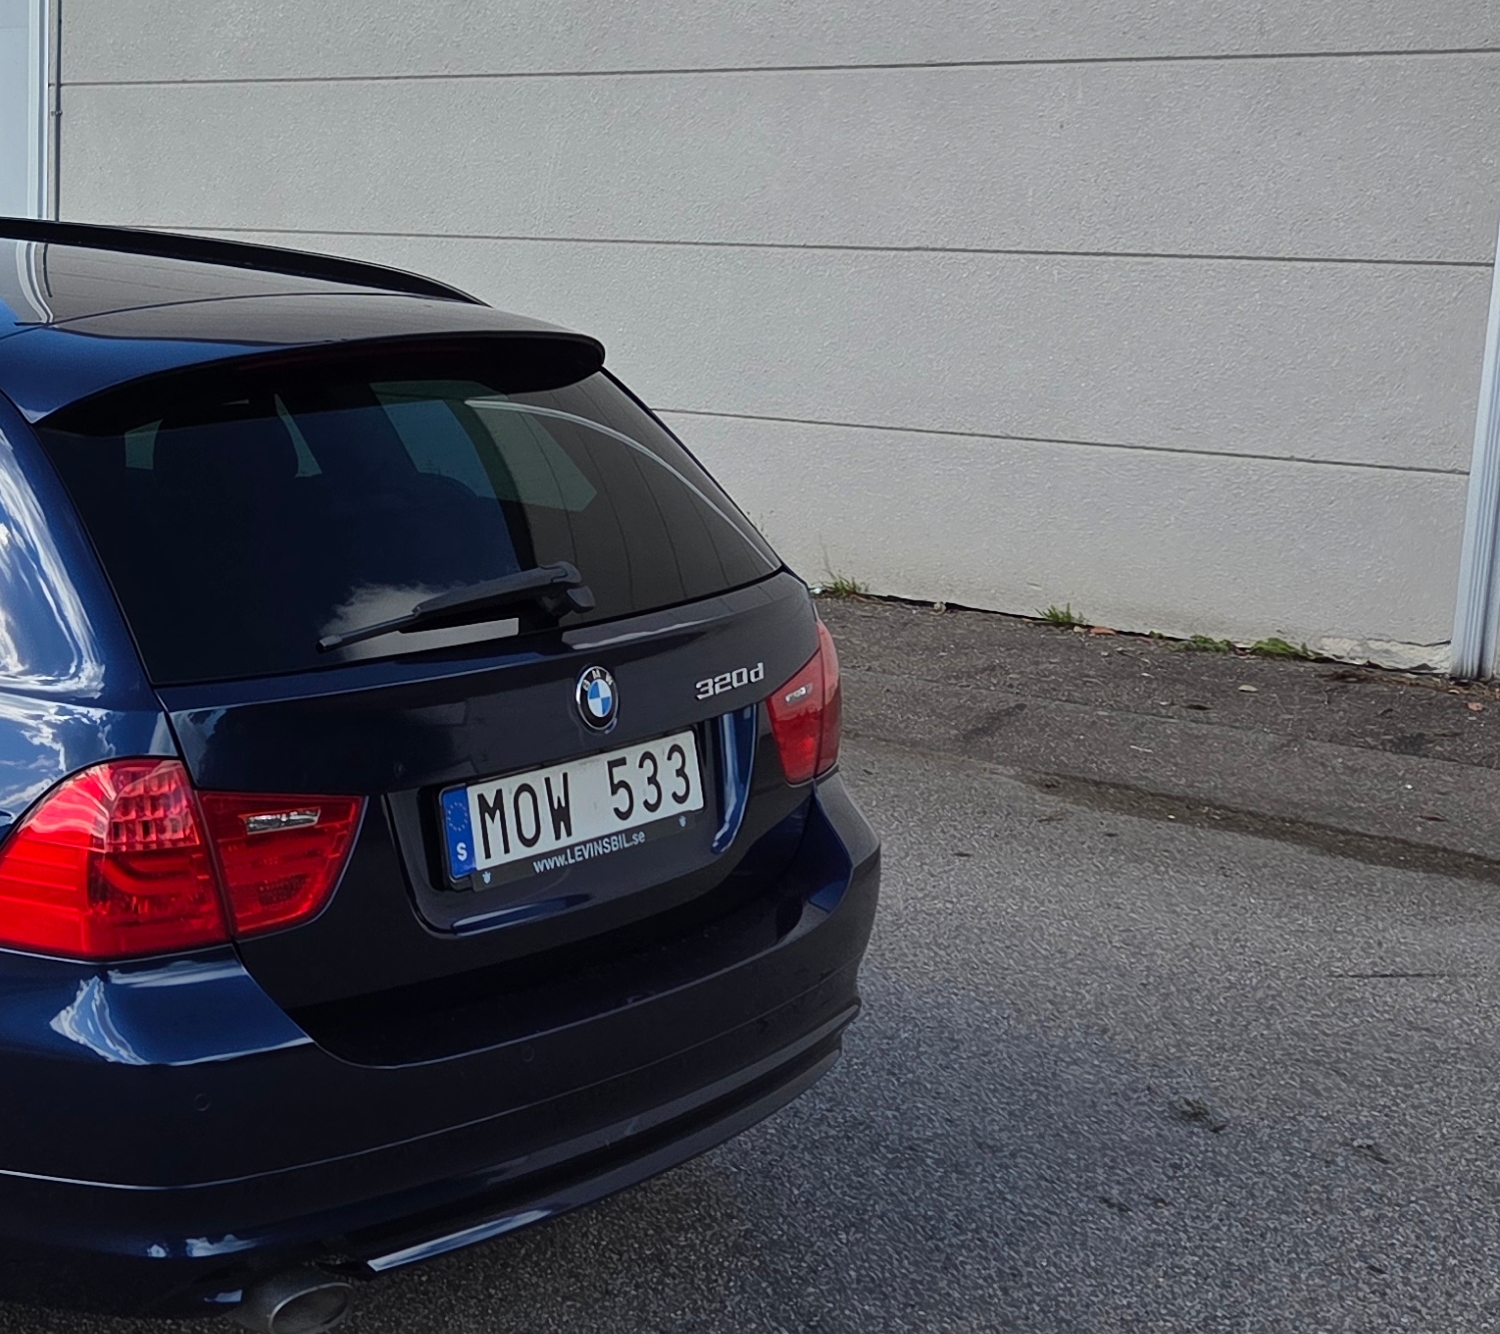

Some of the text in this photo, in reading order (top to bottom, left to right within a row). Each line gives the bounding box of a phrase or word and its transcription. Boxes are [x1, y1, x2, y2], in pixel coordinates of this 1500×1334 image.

[583, 668, 613, 692] BMW
[695, 662, 764, 700] 320d
[477, 743, 690, 860] MOW 533
[456, 842, 467, 861] S
[533, 830, 645, 873] www.LEVINSBIL.se
